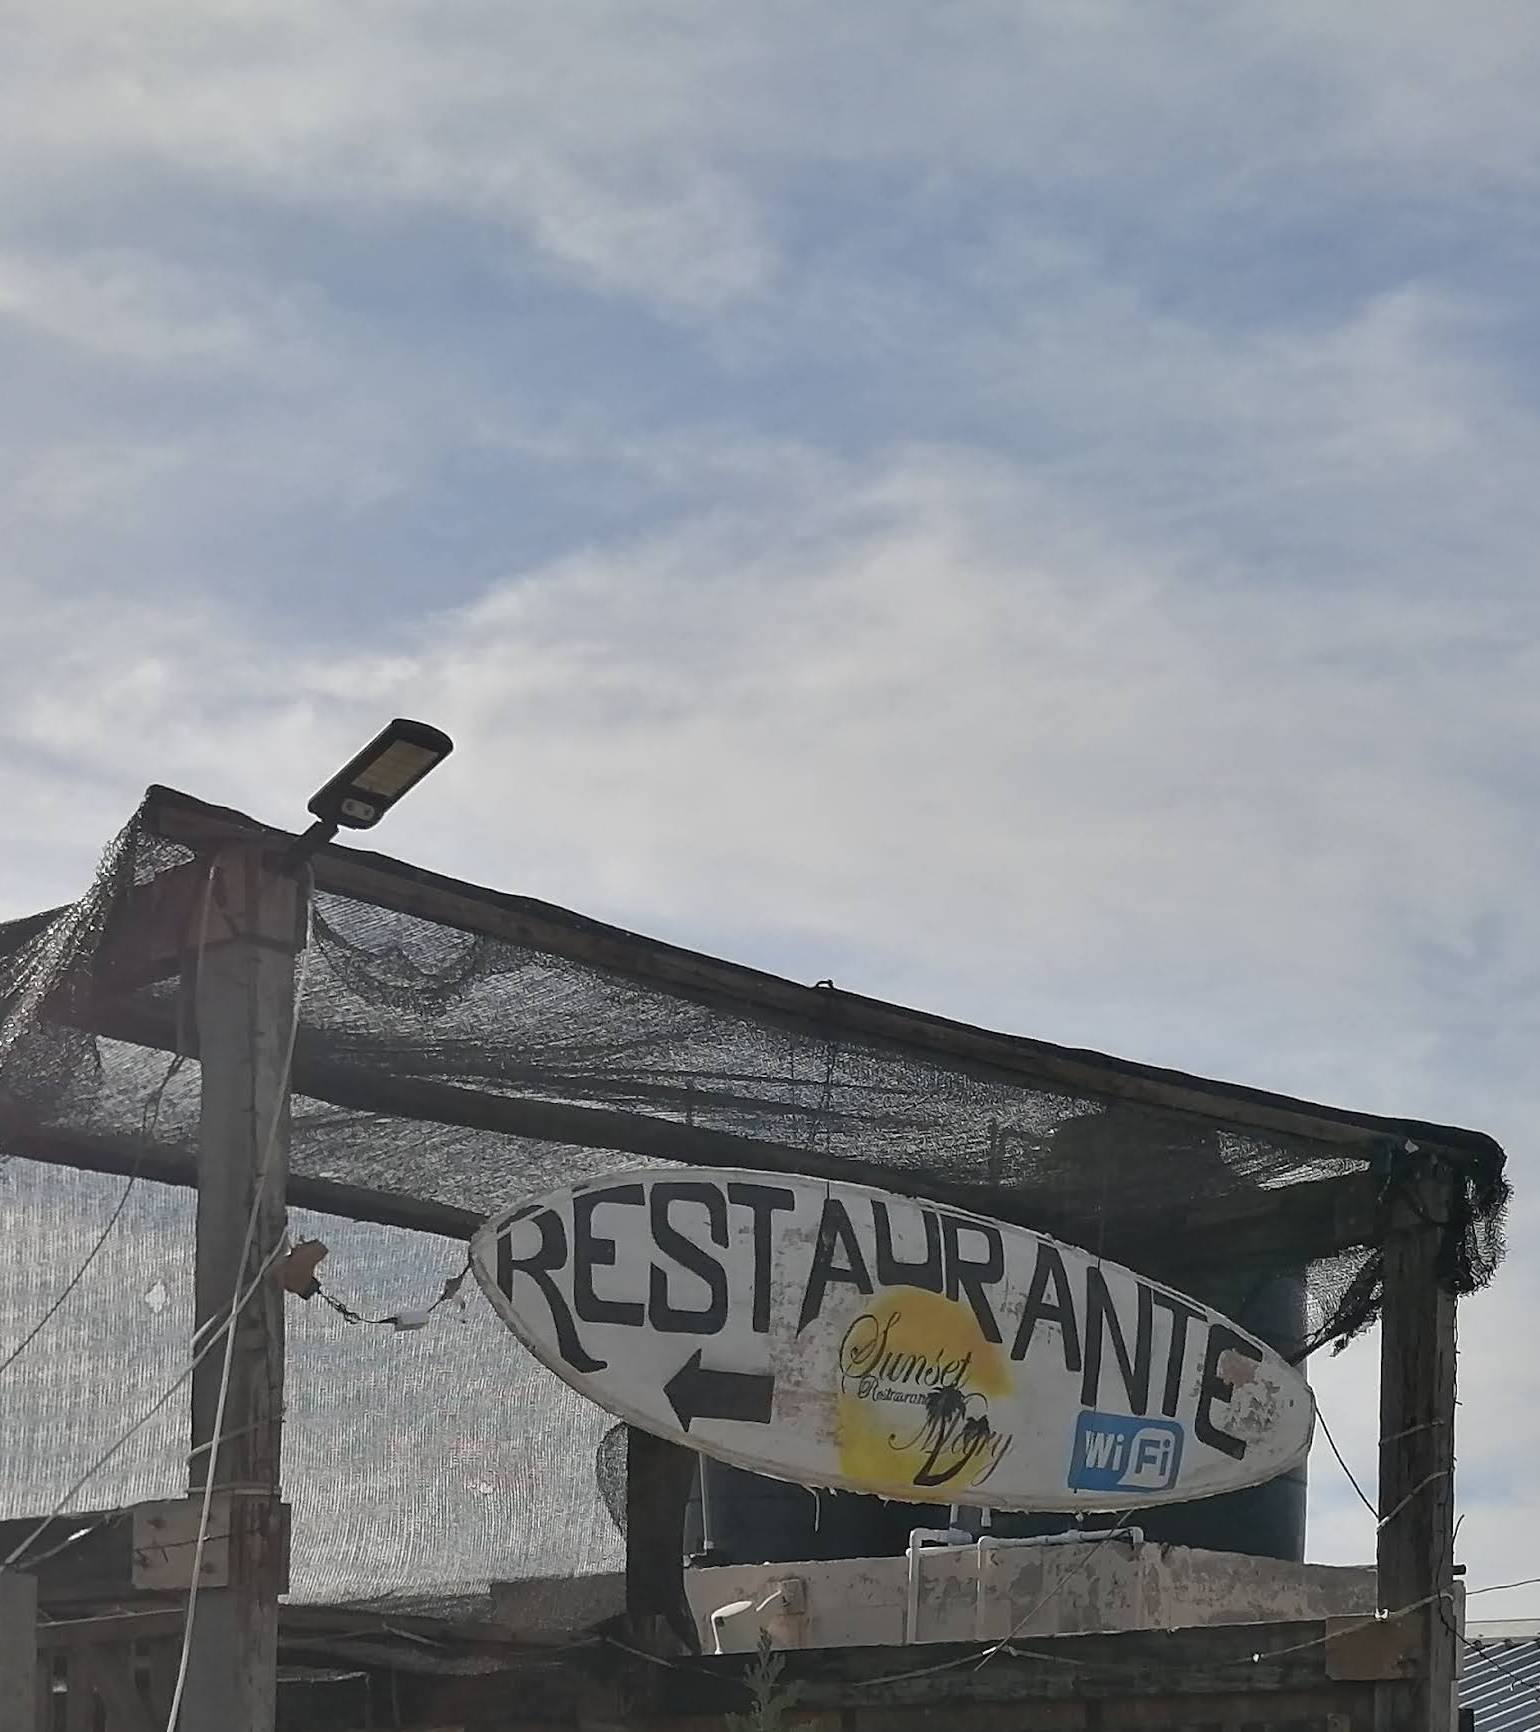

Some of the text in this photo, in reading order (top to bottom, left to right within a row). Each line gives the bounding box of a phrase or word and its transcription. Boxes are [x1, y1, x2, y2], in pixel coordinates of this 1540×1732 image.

[495, 1179, 1263, 1460] RESTAURANTE
[839, 1311, 973, 1393] Sunset
[858, 1376, 930, 1405] Restauran
